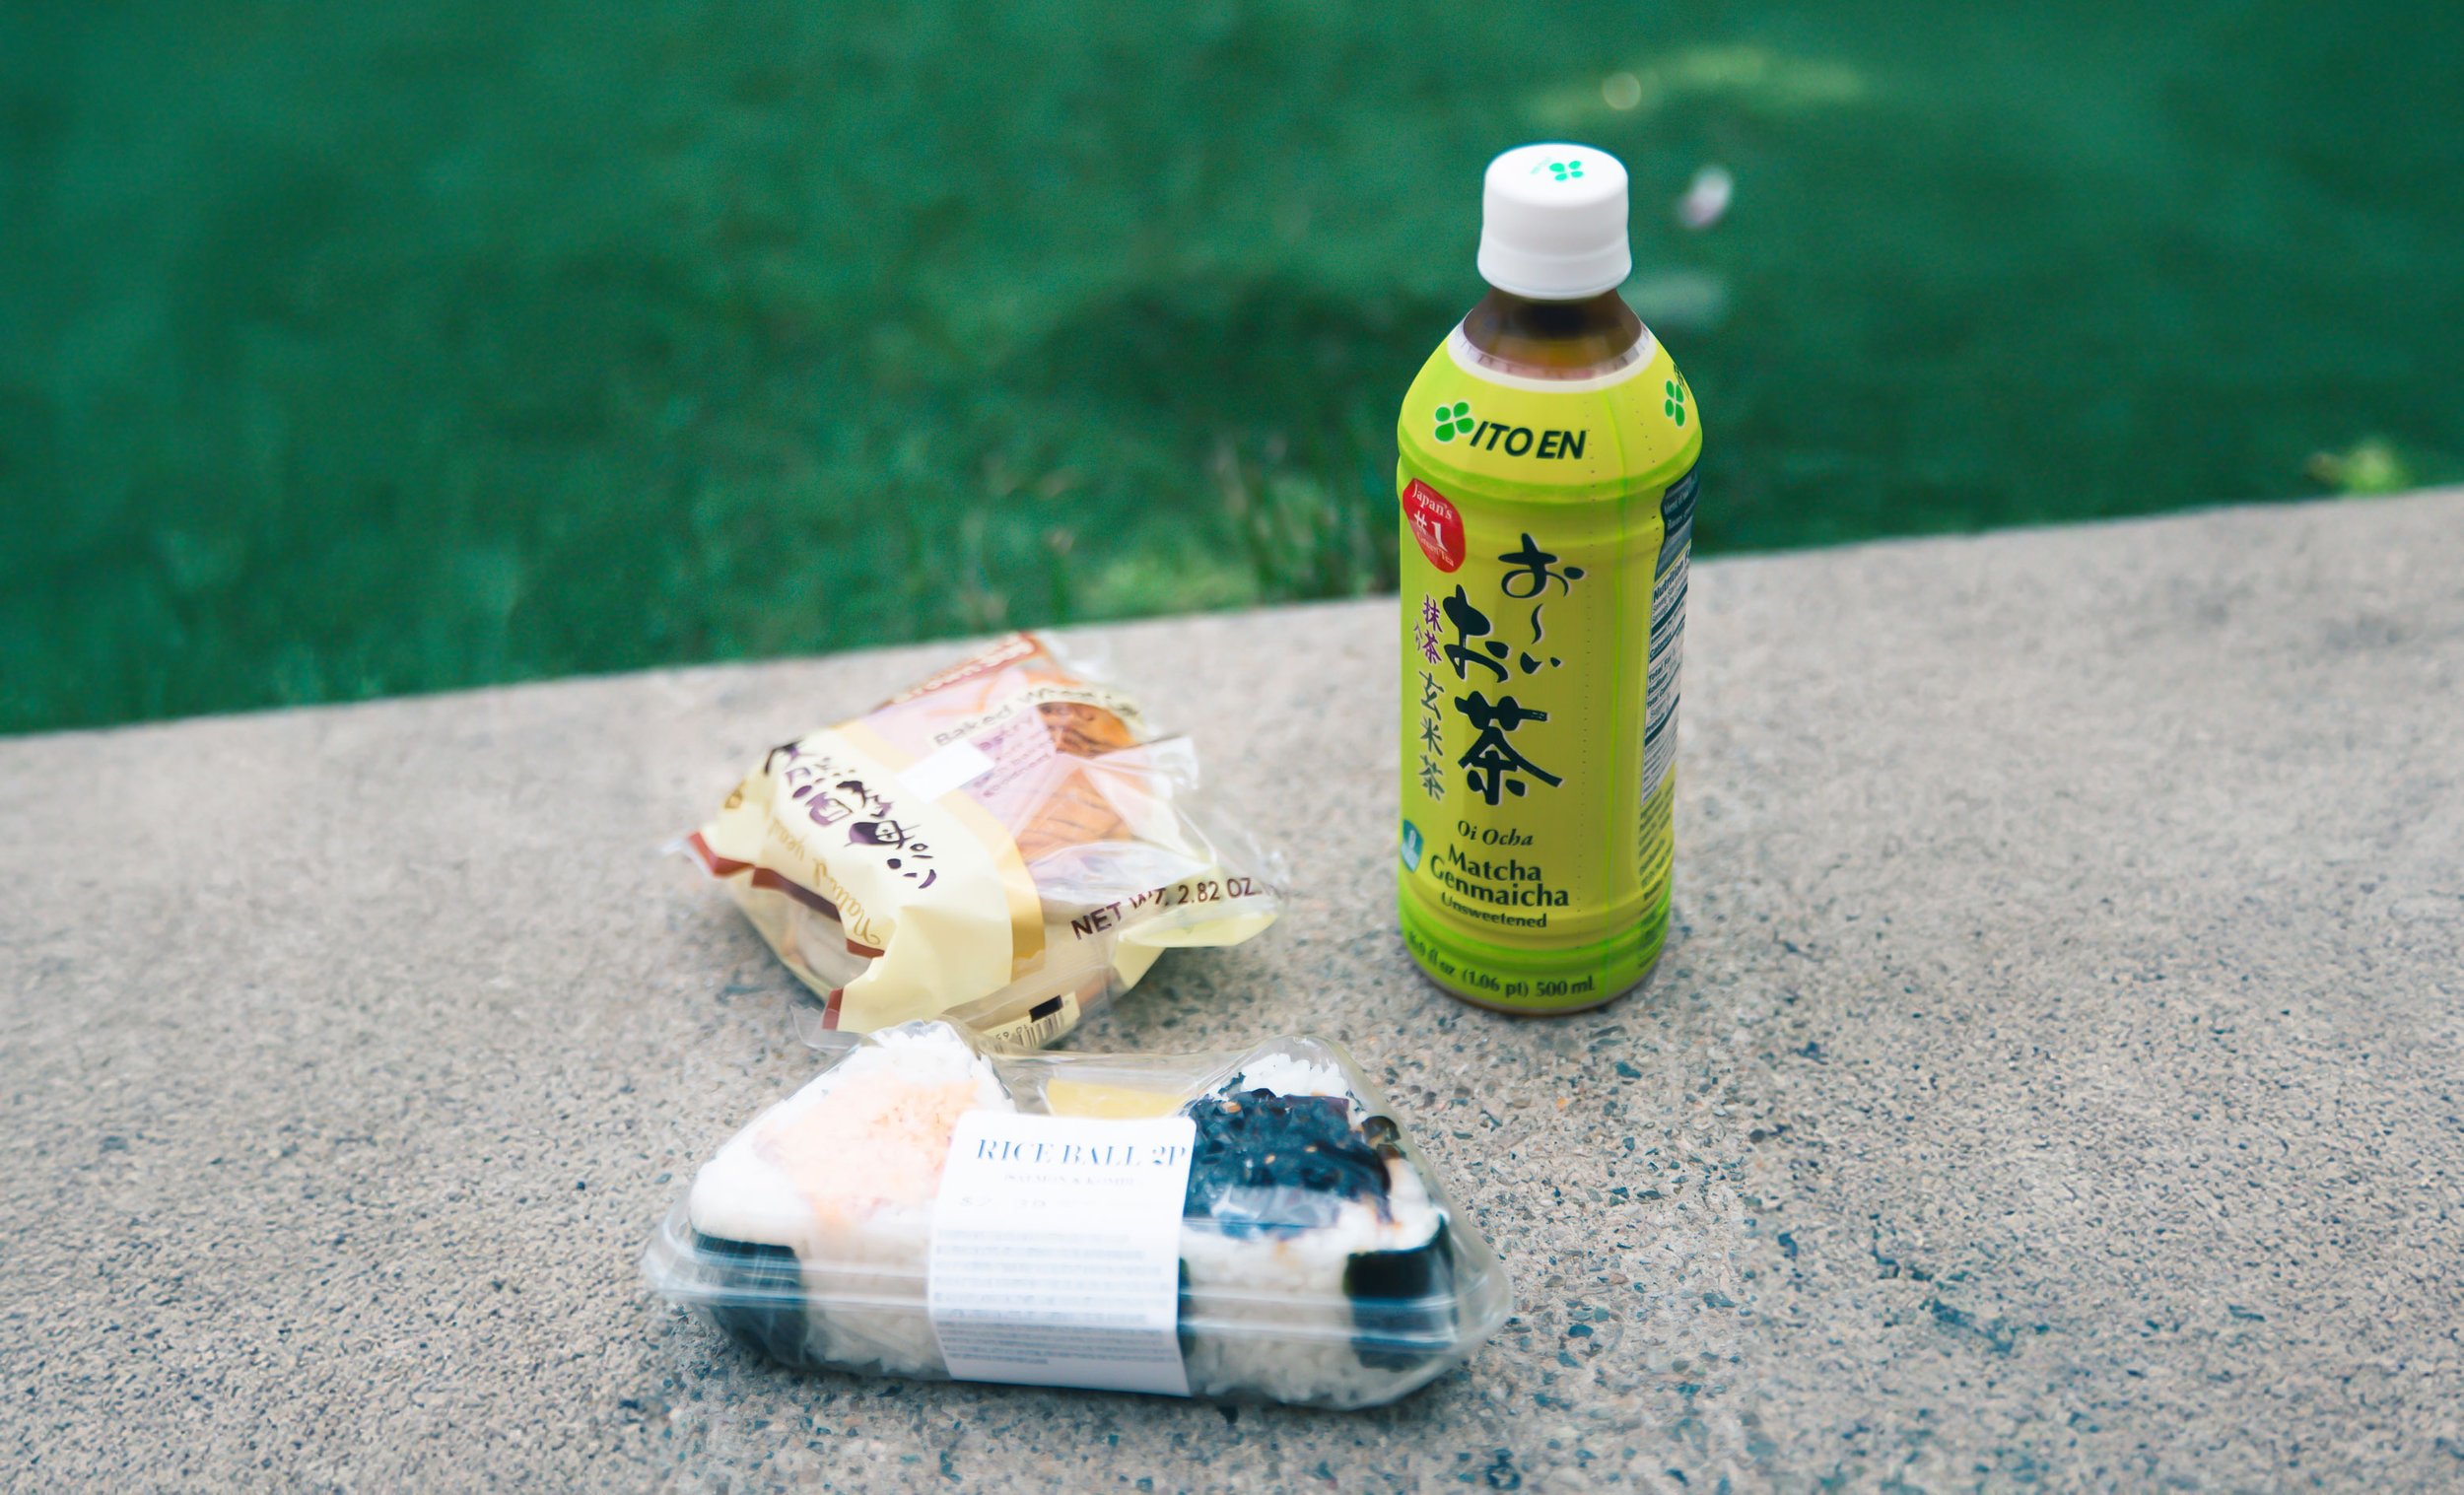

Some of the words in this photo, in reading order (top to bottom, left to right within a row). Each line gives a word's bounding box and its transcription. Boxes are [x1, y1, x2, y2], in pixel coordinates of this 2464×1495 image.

[1470, 421, 1534, 457] ITO
[1537, 430, 1587, 459] EN
[1411, 481, 1453, 519] Japan's
[1413, 510, 1448, 552] #1
[1653, 558, 1684, 603] Nutrition
[1457, 820, 1477, 841] Oi
[1482, 828, 1535, 847] Ocha
[1431, 854, 1570, 907] Genmaicha
[1448, 843, 1542, 882] Matcha
[1071, 901, 1122, 939] NET
[1178, 880, 1221, 905] 2.82
[1441, 891, 1547, 928] Unsweetened
[1536, 981, 1568, 997] 500
[976, 1138, 1055, 1164] RICE
[1062, 1143, 1142, 1167] BALL
